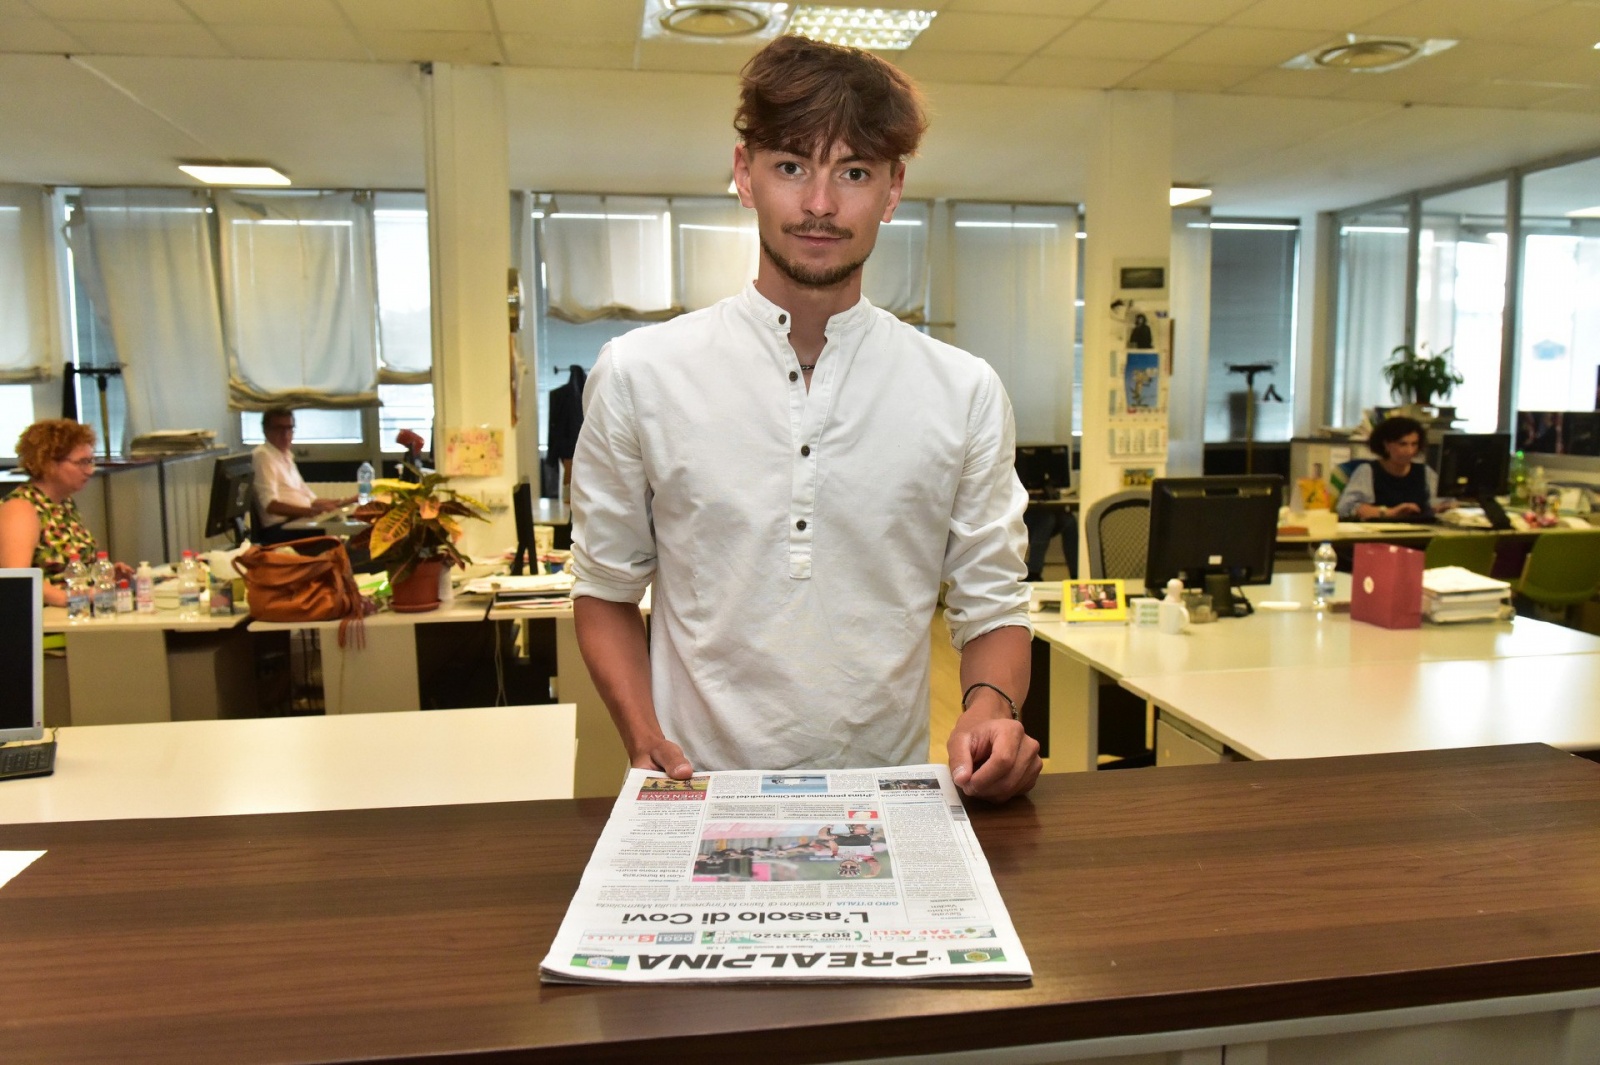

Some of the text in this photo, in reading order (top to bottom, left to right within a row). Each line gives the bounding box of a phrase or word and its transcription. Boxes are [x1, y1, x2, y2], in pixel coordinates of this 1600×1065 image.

[621, 912, 869, 925] L'assolo di Covi
[638, 950, 928, 970] PREALPINA
